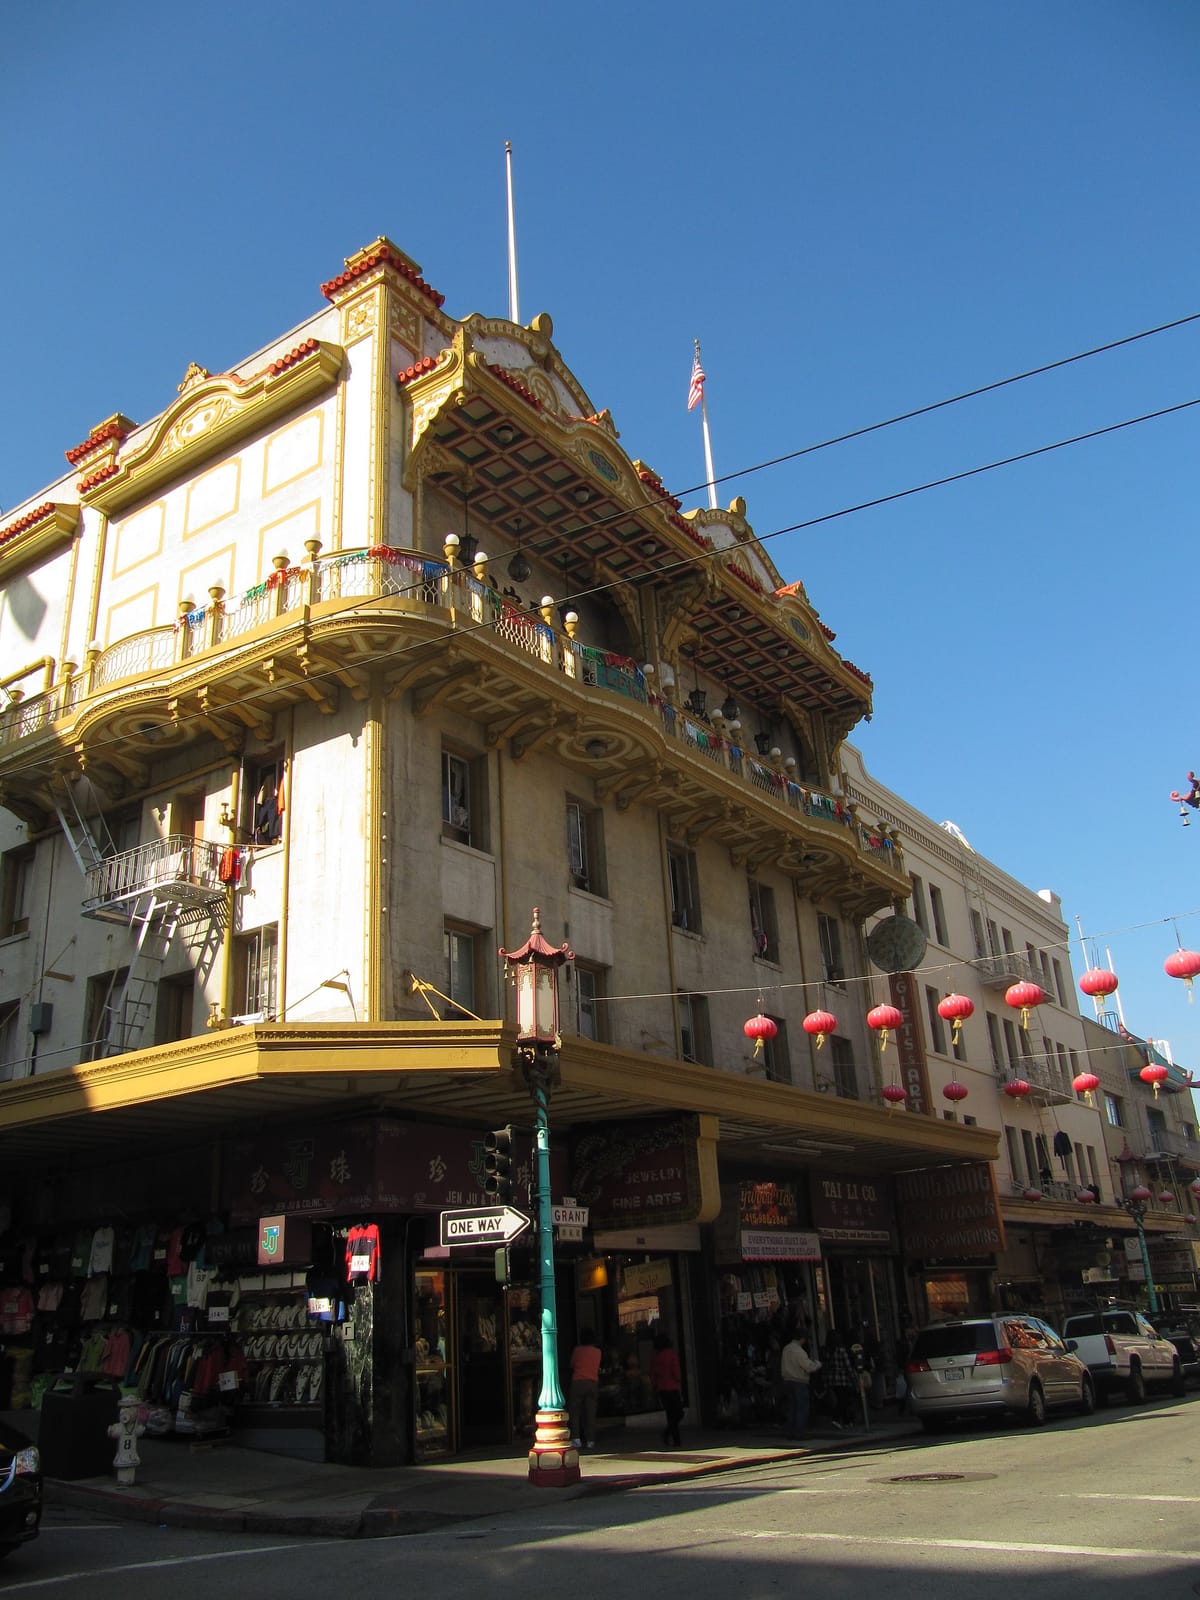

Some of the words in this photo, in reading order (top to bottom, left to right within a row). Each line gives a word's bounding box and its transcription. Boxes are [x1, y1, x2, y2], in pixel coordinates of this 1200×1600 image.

[896, 983, 914, 1051] GIFTS
[908, 1069, 923, 1113] ART
[624, 1168, 682, 1184] JEWELRY
[944, 1166, 991, 1195] KONG
[446, 1191, 463, 1204] JEN
[466, 1192, 477, 1205] JU
[823, 1181, 842, 1199] TAI
[847, 1184, 858, 1200] LI
[612, 1196, 641, 1209] FINE
[645, 1192, 682, 1207] ARTS
[554, 1210, 586, 1223] GRANT
[450, 1222, 473, 1234] ONE
[477, 1217, 502, 1231] WAY
[124, 1439, 131, 1450] 8
